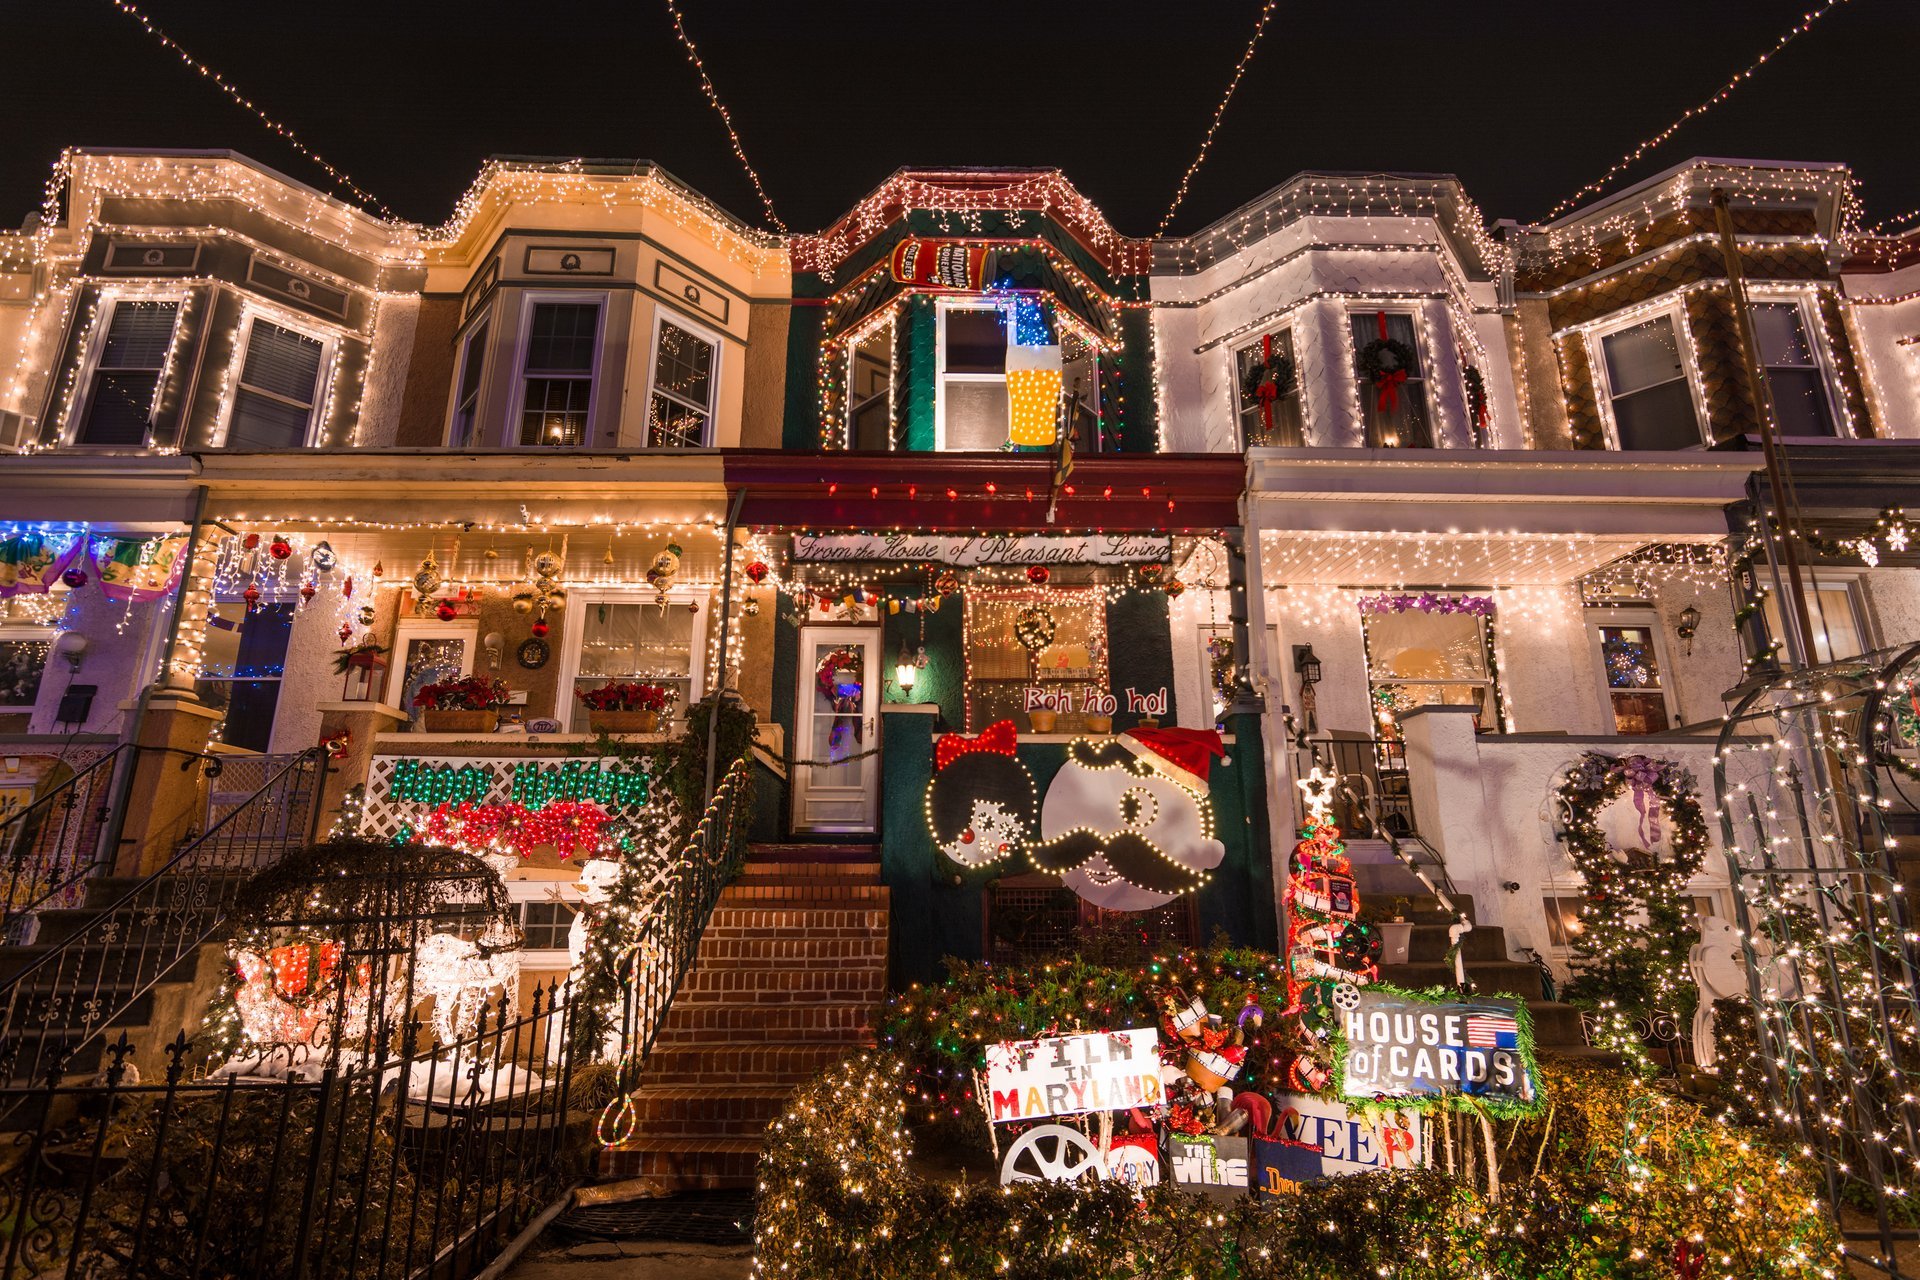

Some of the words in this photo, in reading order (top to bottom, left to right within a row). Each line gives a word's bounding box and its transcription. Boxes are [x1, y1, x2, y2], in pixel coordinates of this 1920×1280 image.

[904, 260, 913, 277] BEER
[941, 247, 953, 285] BOHEMIAN
[951, 246, 966, 287] NATIONAL
[795, 535, 851, 559] From
[851, 542, 875, 558] the
[879, 536, 938, 558] House
[950, 538, 975, 562] of
[975, 537, 1088, 563] Pleasant
[1101, 536, 1169, 562] Living
[1023, 687, 1072, 713] Boh
[1080, 687, 1117, 715] ho
[1126, 687, 1167, 715] ho!
[390, 759, 494, 811] Happy
[511, 760, 650, 811] Holidays
[1346, 1011, 1464, 1047] HOUSE
[1018, 1033, 1132, 1071] FILM
[1355, 1044, 1383, 1083] of
[1389, 1046, 1515, 1087] CARDS
[1065, 1065, 1092, 1082] IN
[993, 1074, 1160, 1119] MARYLAND
[1183, 1144, 1212, 1159] THE
